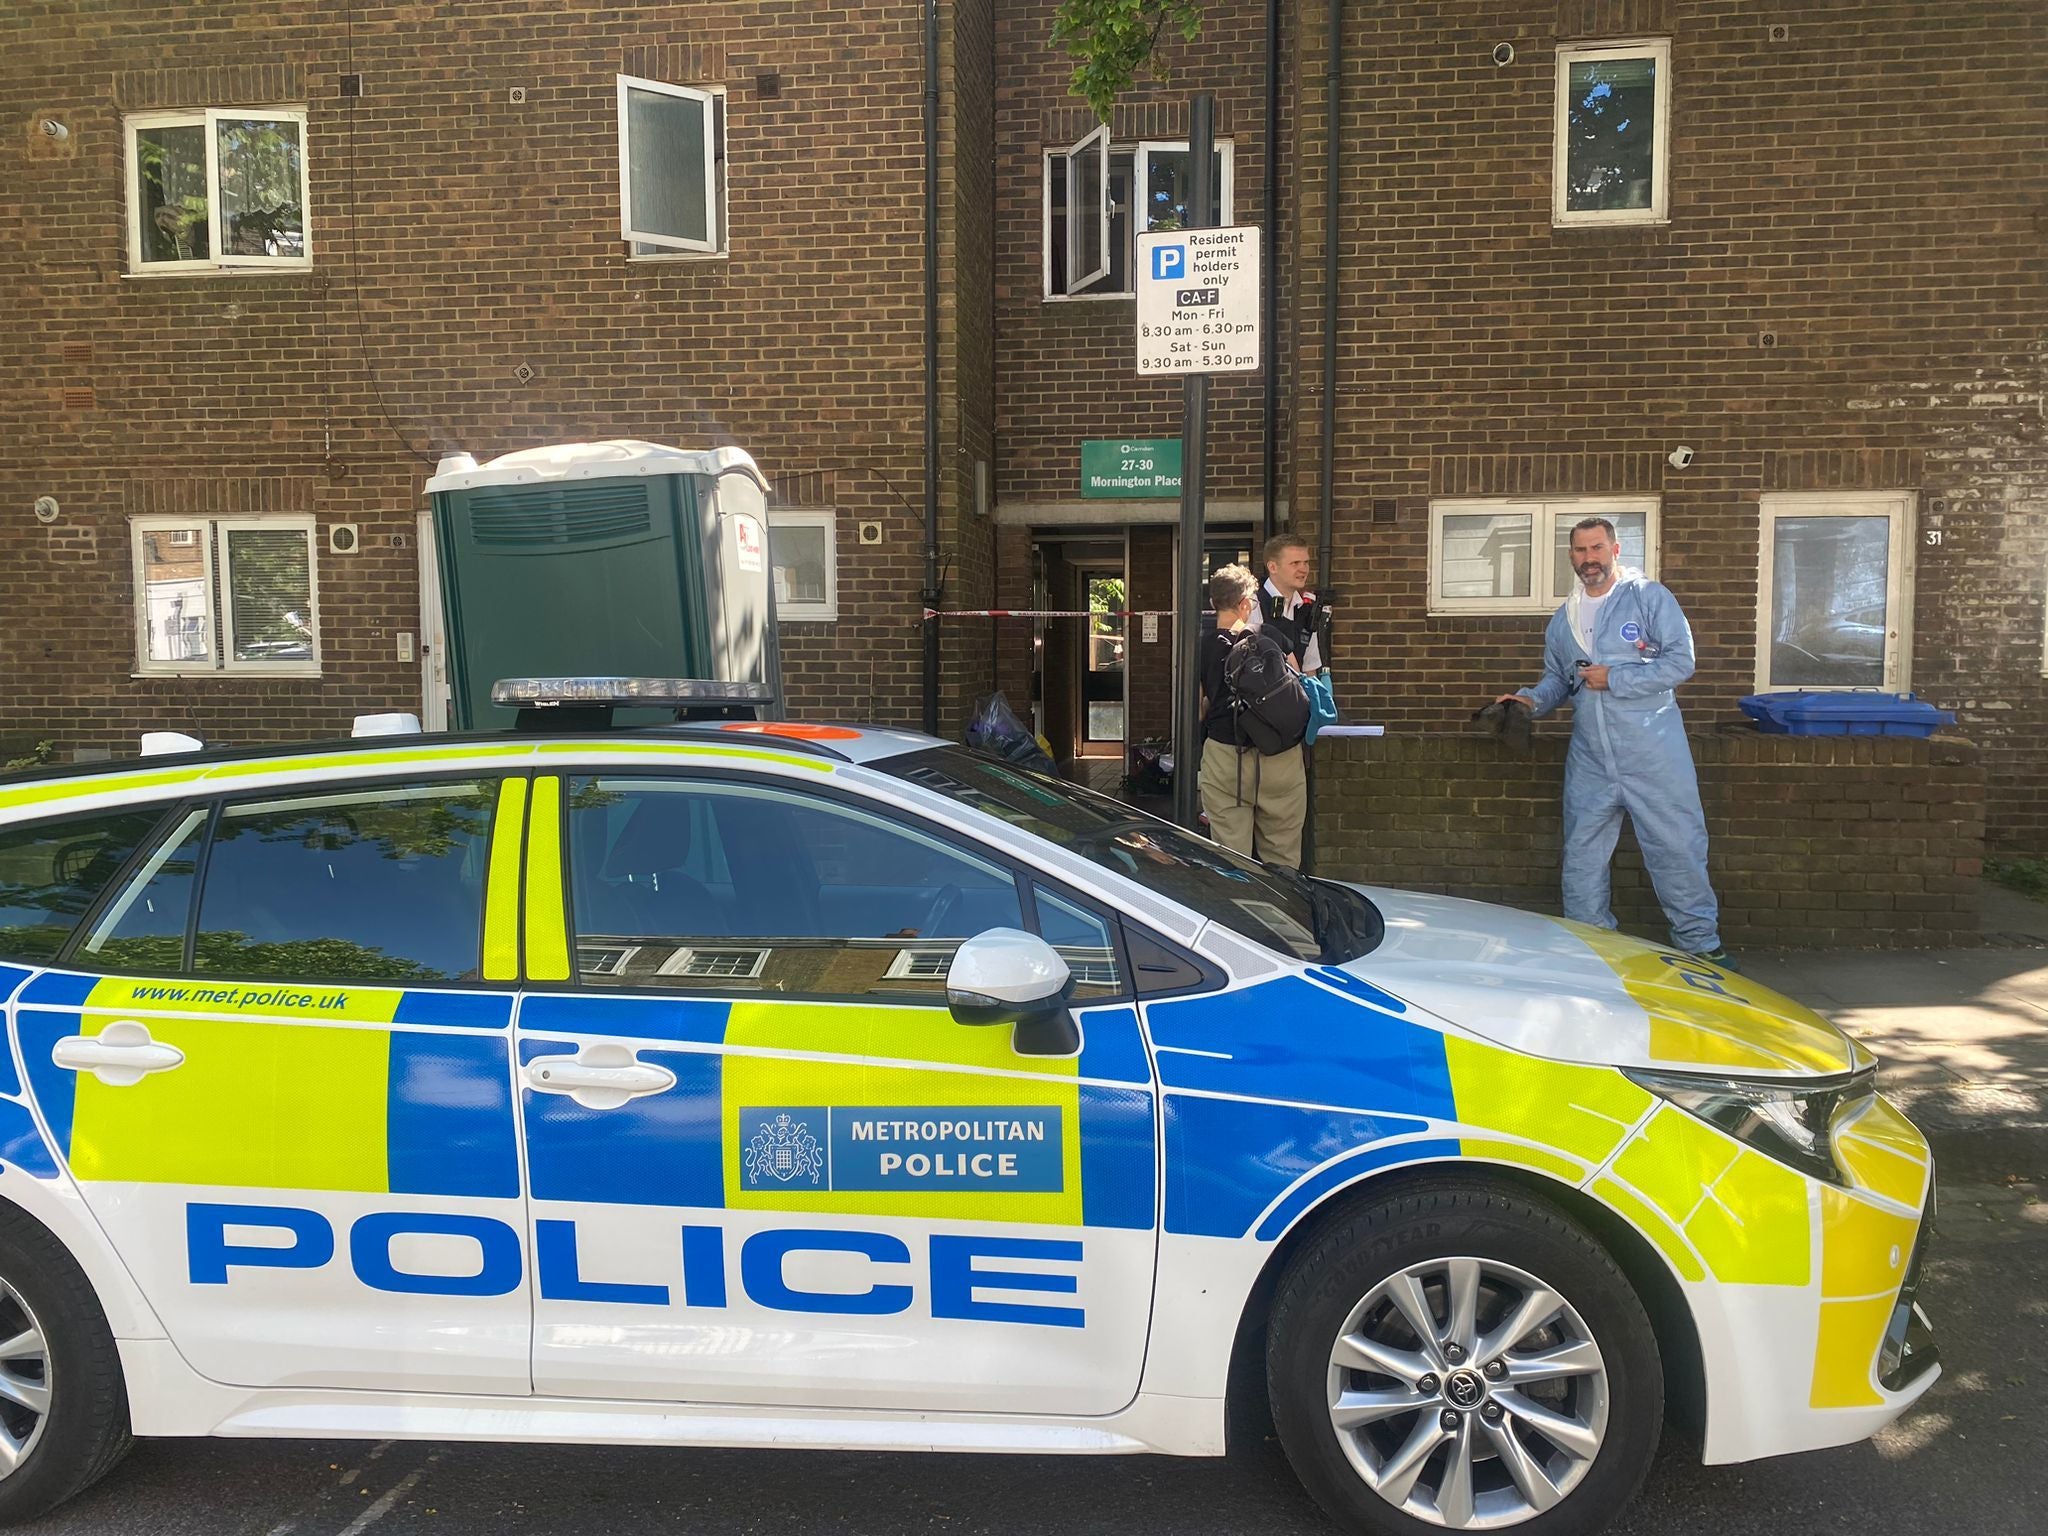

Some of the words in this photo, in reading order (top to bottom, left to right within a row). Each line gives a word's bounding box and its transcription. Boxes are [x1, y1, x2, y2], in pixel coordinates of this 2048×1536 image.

[1190, 233, 1244, 246] Resident
[1196, 247, 1237, 260] permit
[1159, 249, 1180, 276] P
[1193, 261, 1239, 272] holders
[1203, 274, 1229, 286] only
[1180, 290, 1216, 305] CA-F
[1172, 310, 1198, 321] Mon
[1208, 308, 1225, 319] Fri
[1142, 326, 1171, 337] 8.30
[1174, 327, 1193, 336] am
[1202, 323, 1232, 334] 6.30
[1235, 323, 1254, 335] pm
[1170, 341, 1191, 352] Sat
[1201, 340, 1226, 351] Sun
[1142, 357, 1171, 369] 9.30
[1174, 358, 1192, 367] am
[1202, 355, 1232, 366] 5.30
[1235, 355, 1254, 366] pm
[1120, 459, 1154, 470] 27-30
[1091, 476, 1151, 488] Mornington
[1926, 530, 1942, 545] 31
[131, 985, 349, 1010] www.met.police.uk
[851, 1120, 1044, 1141] METROPOLITAN
[879, 1152, 1019, 1178] POLICE
[187, 1202, 1086, 1328] POLICE
